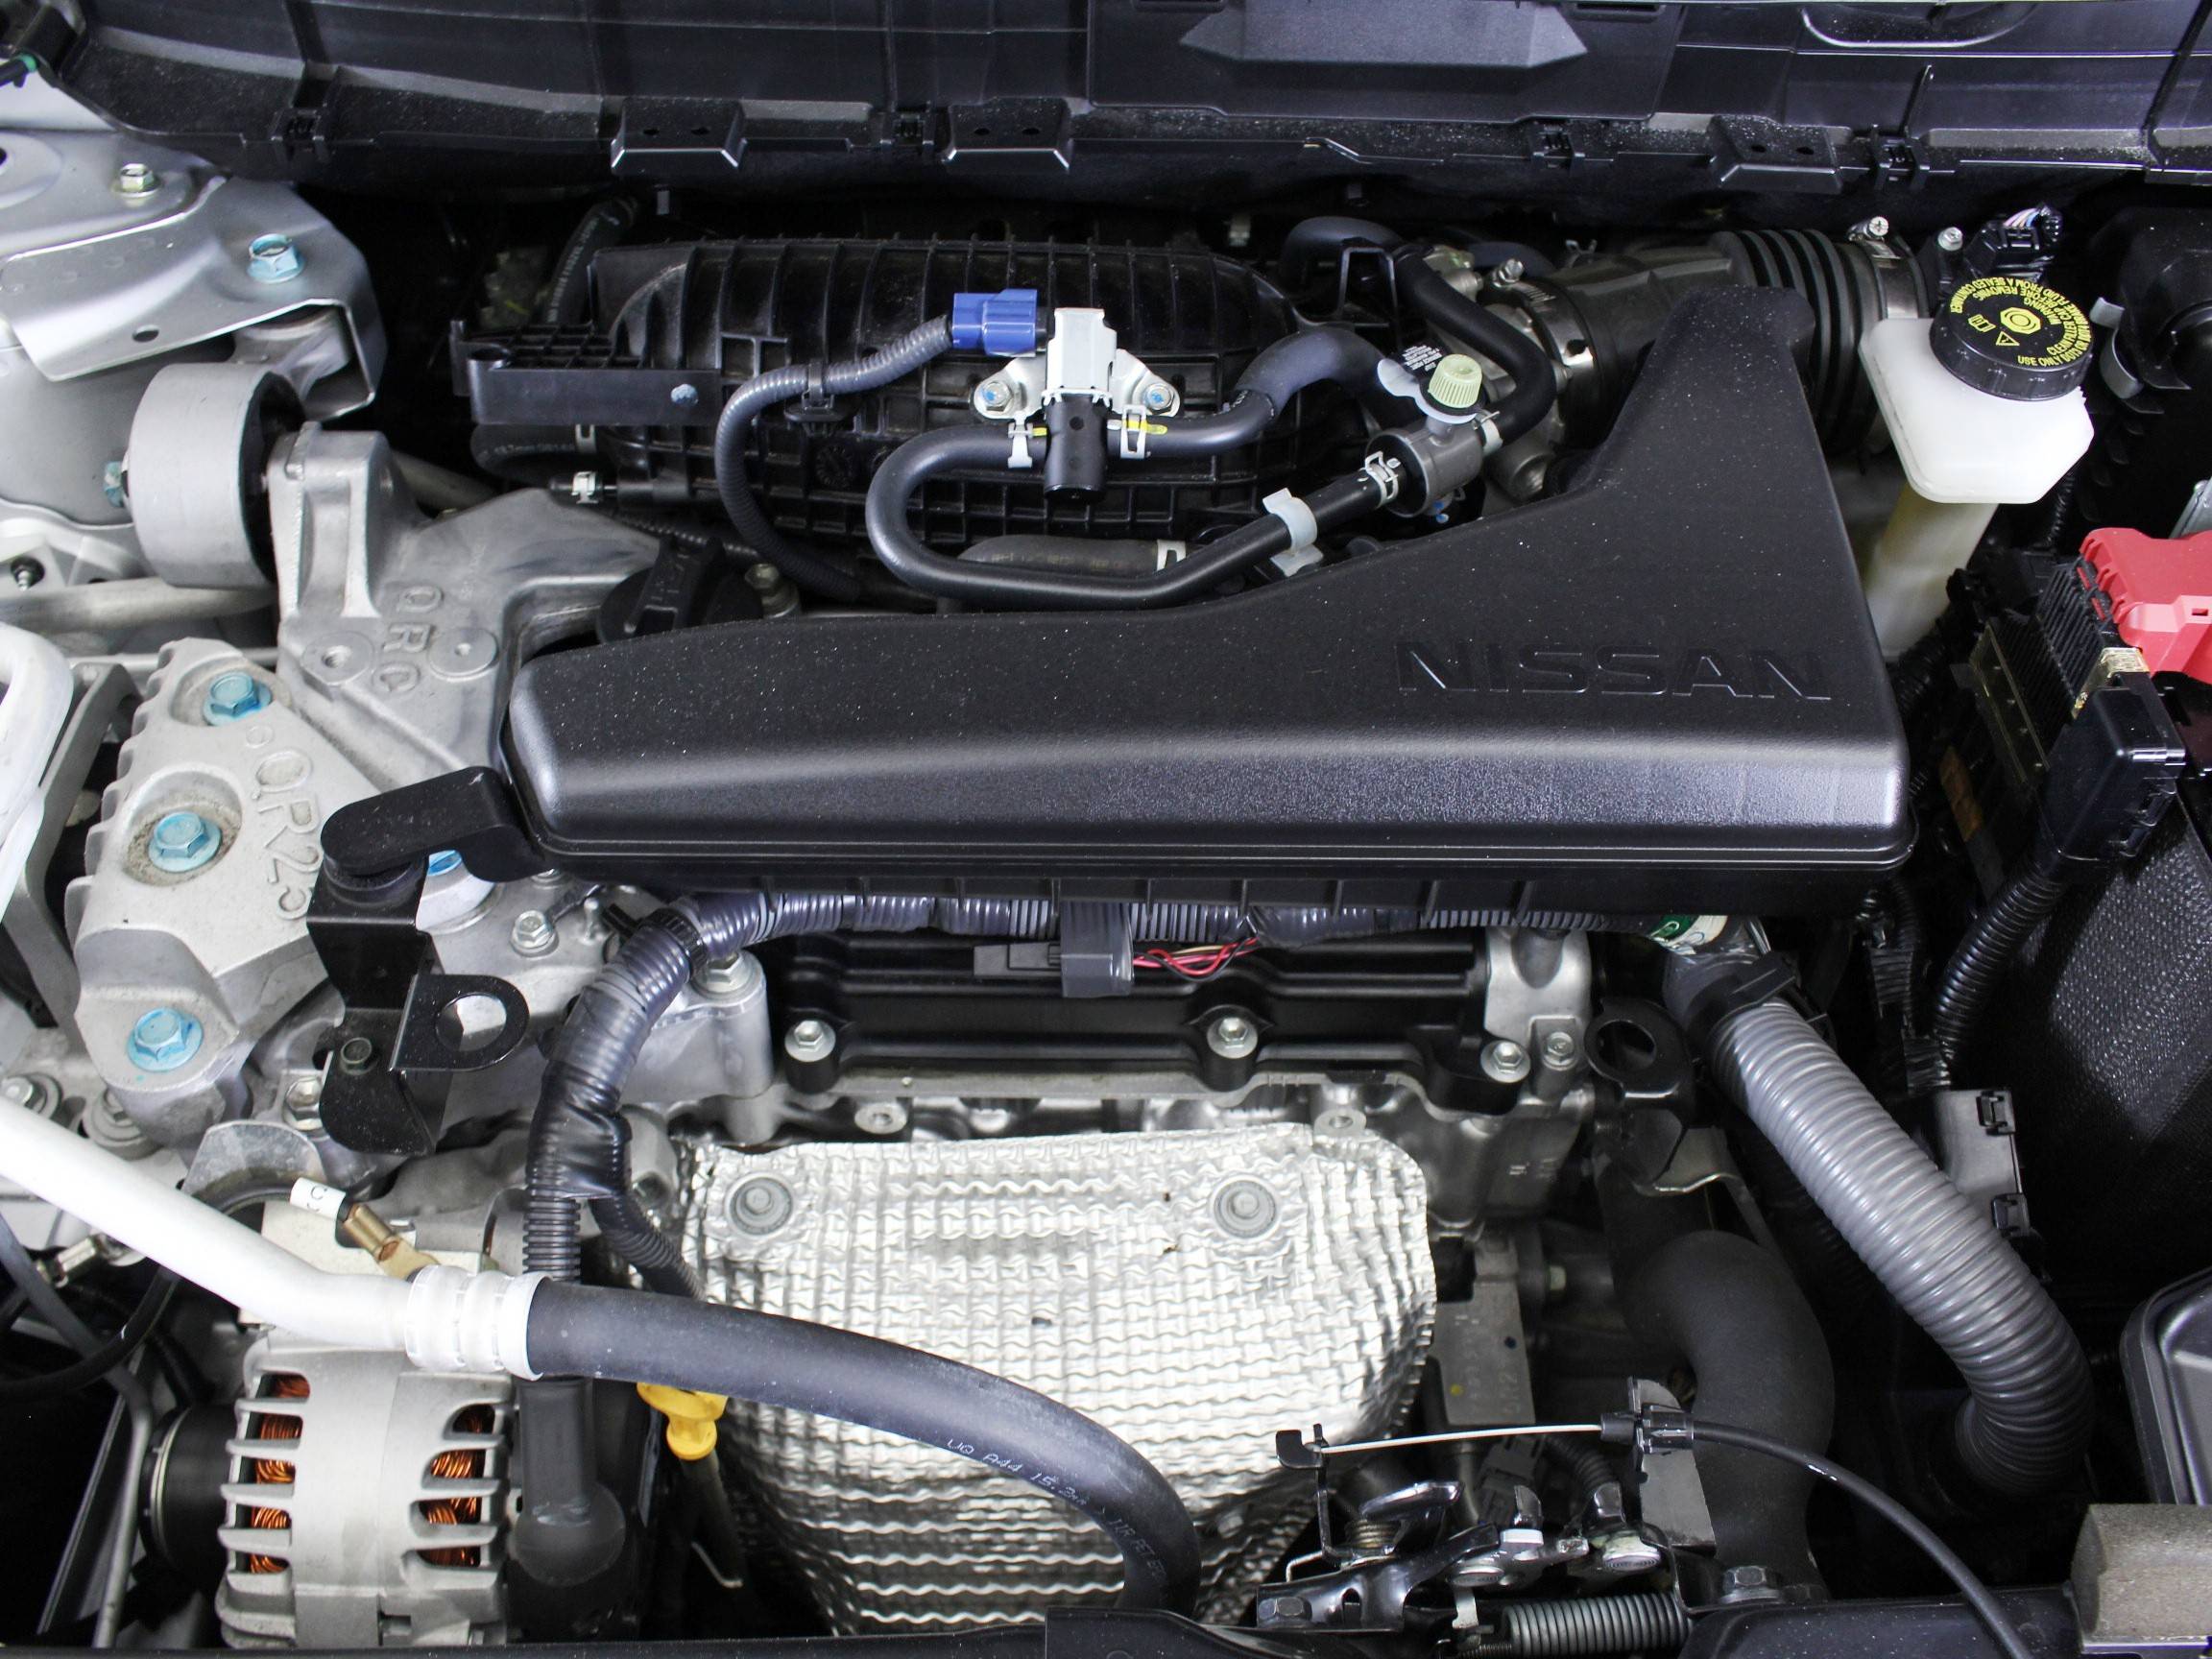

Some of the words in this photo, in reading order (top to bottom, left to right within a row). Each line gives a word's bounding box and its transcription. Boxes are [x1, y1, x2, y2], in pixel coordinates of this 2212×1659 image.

[1972, 277, 2007, 290] SEALED
[2015, 279, 2043, 293] FROM
[1972, 285, 2018, 301] REMOVING
[2020, 287, 2060, 308] BEFORE
[2043, 289, 2070, 305] FLUID
[2024, 297, 2062, 325] WARNING
[2054, 305, 2074, 320] CAP
[2063, 303, 2088, 325] BRAKE
[2047, 339, 2073, 355] CLEAN
[2018, 355, 2037, 366] USE
[2038, 354, 2062, 366] ONLY
[1393, 641, 1833, 701] NISSAN
